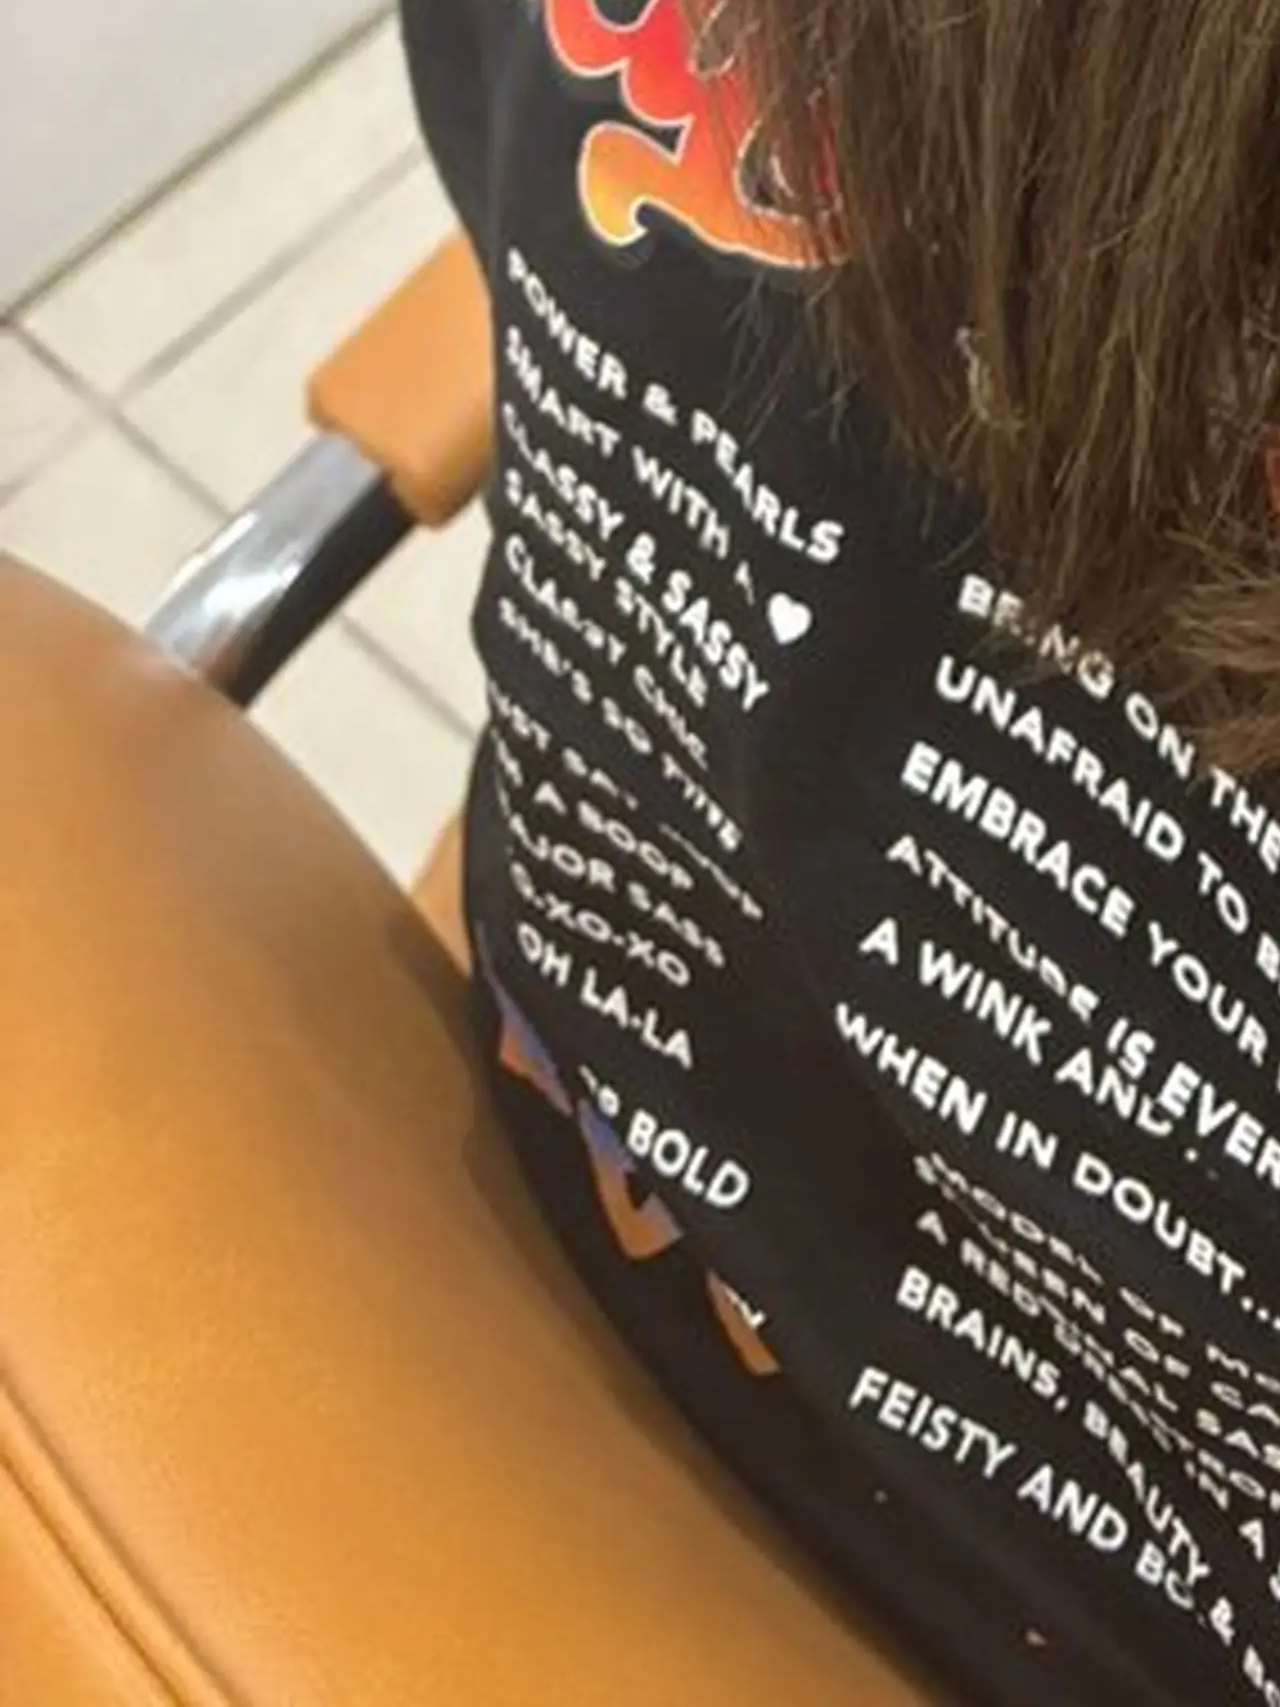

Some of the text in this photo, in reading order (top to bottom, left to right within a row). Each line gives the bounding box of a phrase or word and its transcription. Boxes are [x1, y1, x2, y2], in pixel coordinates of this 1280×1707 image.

[506, 324, 622, 459] SMART
[632, 444, 730, 559] WITH
[507, 245, 845, 565] POWER & PEARLS
[502, 400, 625, 542] CLASSY
[625, 531, 656, 585] &
[662, 569, 769, 712] SASSY
[505, 467, 607, 582] SASSY
[613, 575, 708, 709] STYLE
[935, 654, 1187, 863] UNAFRAID
[1198, 851, 1250, 935] TO
[957, 574, 1114, 700] BENG
[1125, 693, 1194, 779] ON
[858, 916, 899, 967] A
[918, 939, 1053, 1067] WINK
[885, 833, 1099, 1025] ATTITUDE
[1107, 1016, 1156, 1081] IS
[900, 740, 1136, 939] EMBRACE
[1147, 919, 1269, 1067] YOUR
[626, 1108, 750, 1209] BOLD
[834, 1001, 988, 1135] WHEN
[995, 1111, 1059, 1171] IN
[848, 1365, 1017, 1481] FEISTY
[1016, 1462, 1130, 1553] AND
[895, 1264, 1069, 1414] BRAINS,
[1082, 1399, 1212, 1589] BEAUTY
[1238, 1518, 1266, 1563] A
